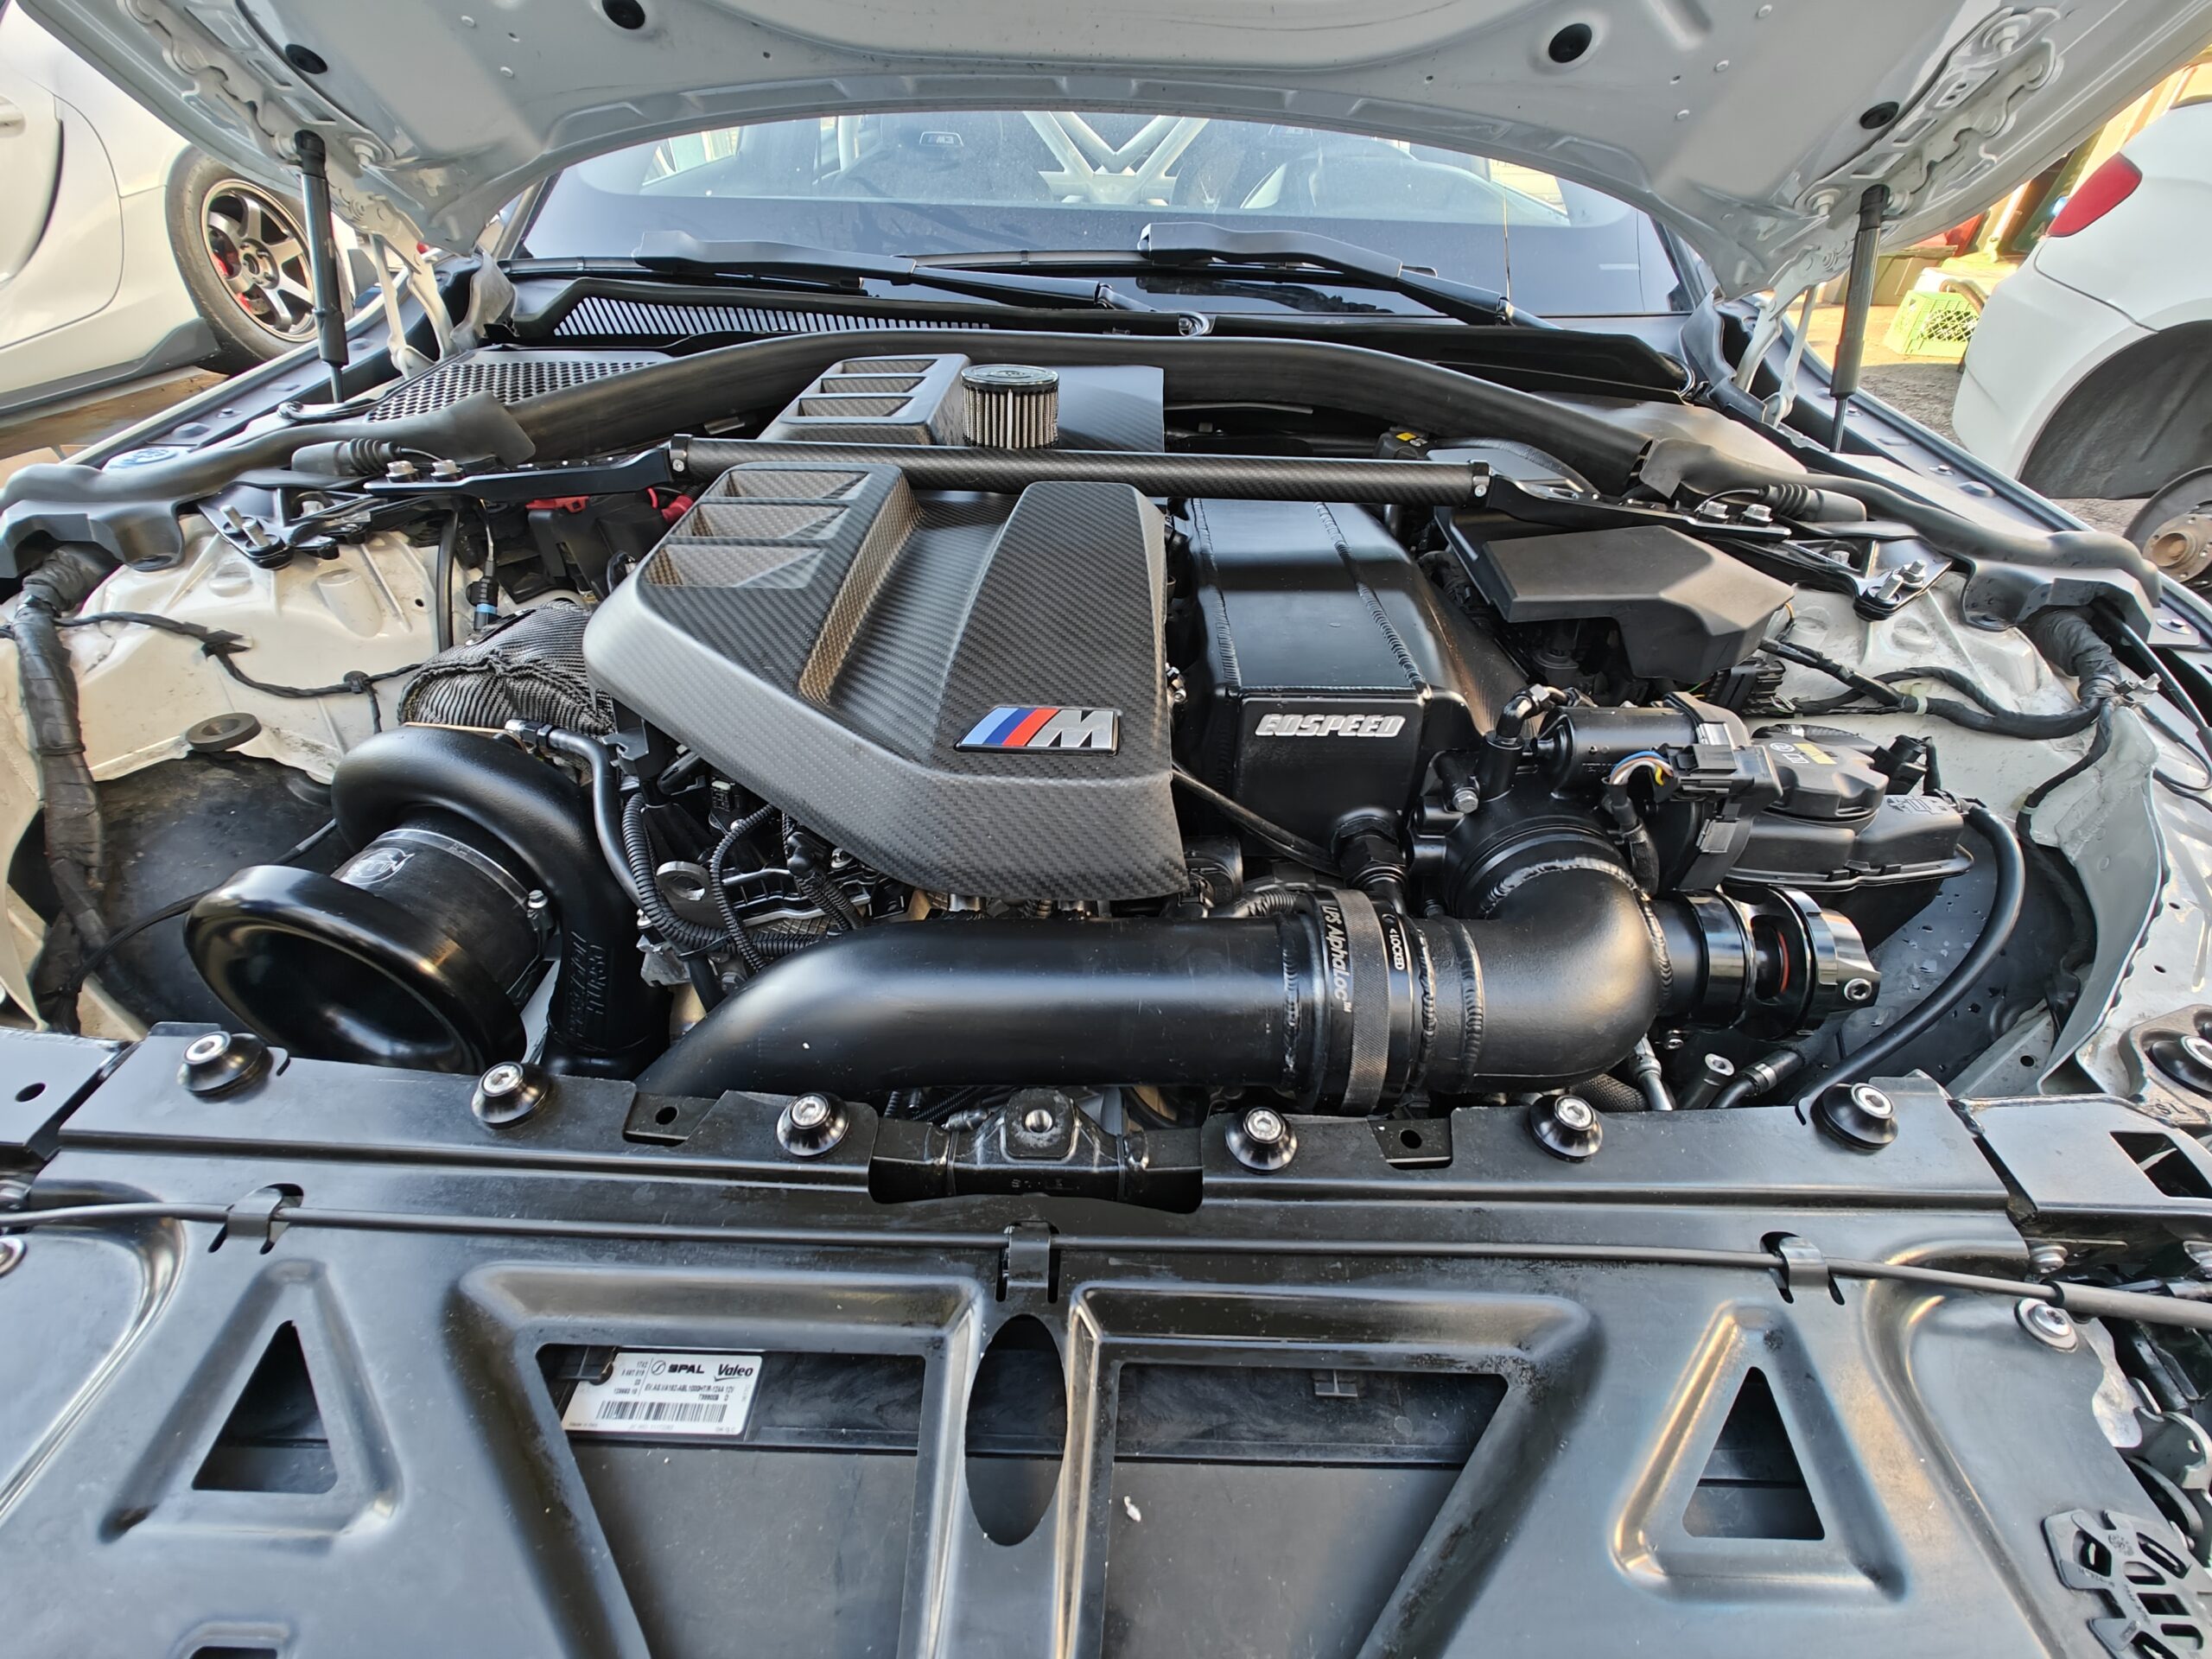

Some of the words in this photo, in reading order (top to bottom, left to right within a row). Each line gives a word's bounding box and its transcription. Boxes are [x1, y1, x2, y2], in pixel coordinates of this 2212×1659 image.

[1027, 709, 1114, 748] M
[667, 1363, 705, 1374] SPAL
[717, 1363, 753, 1376] Valeo
